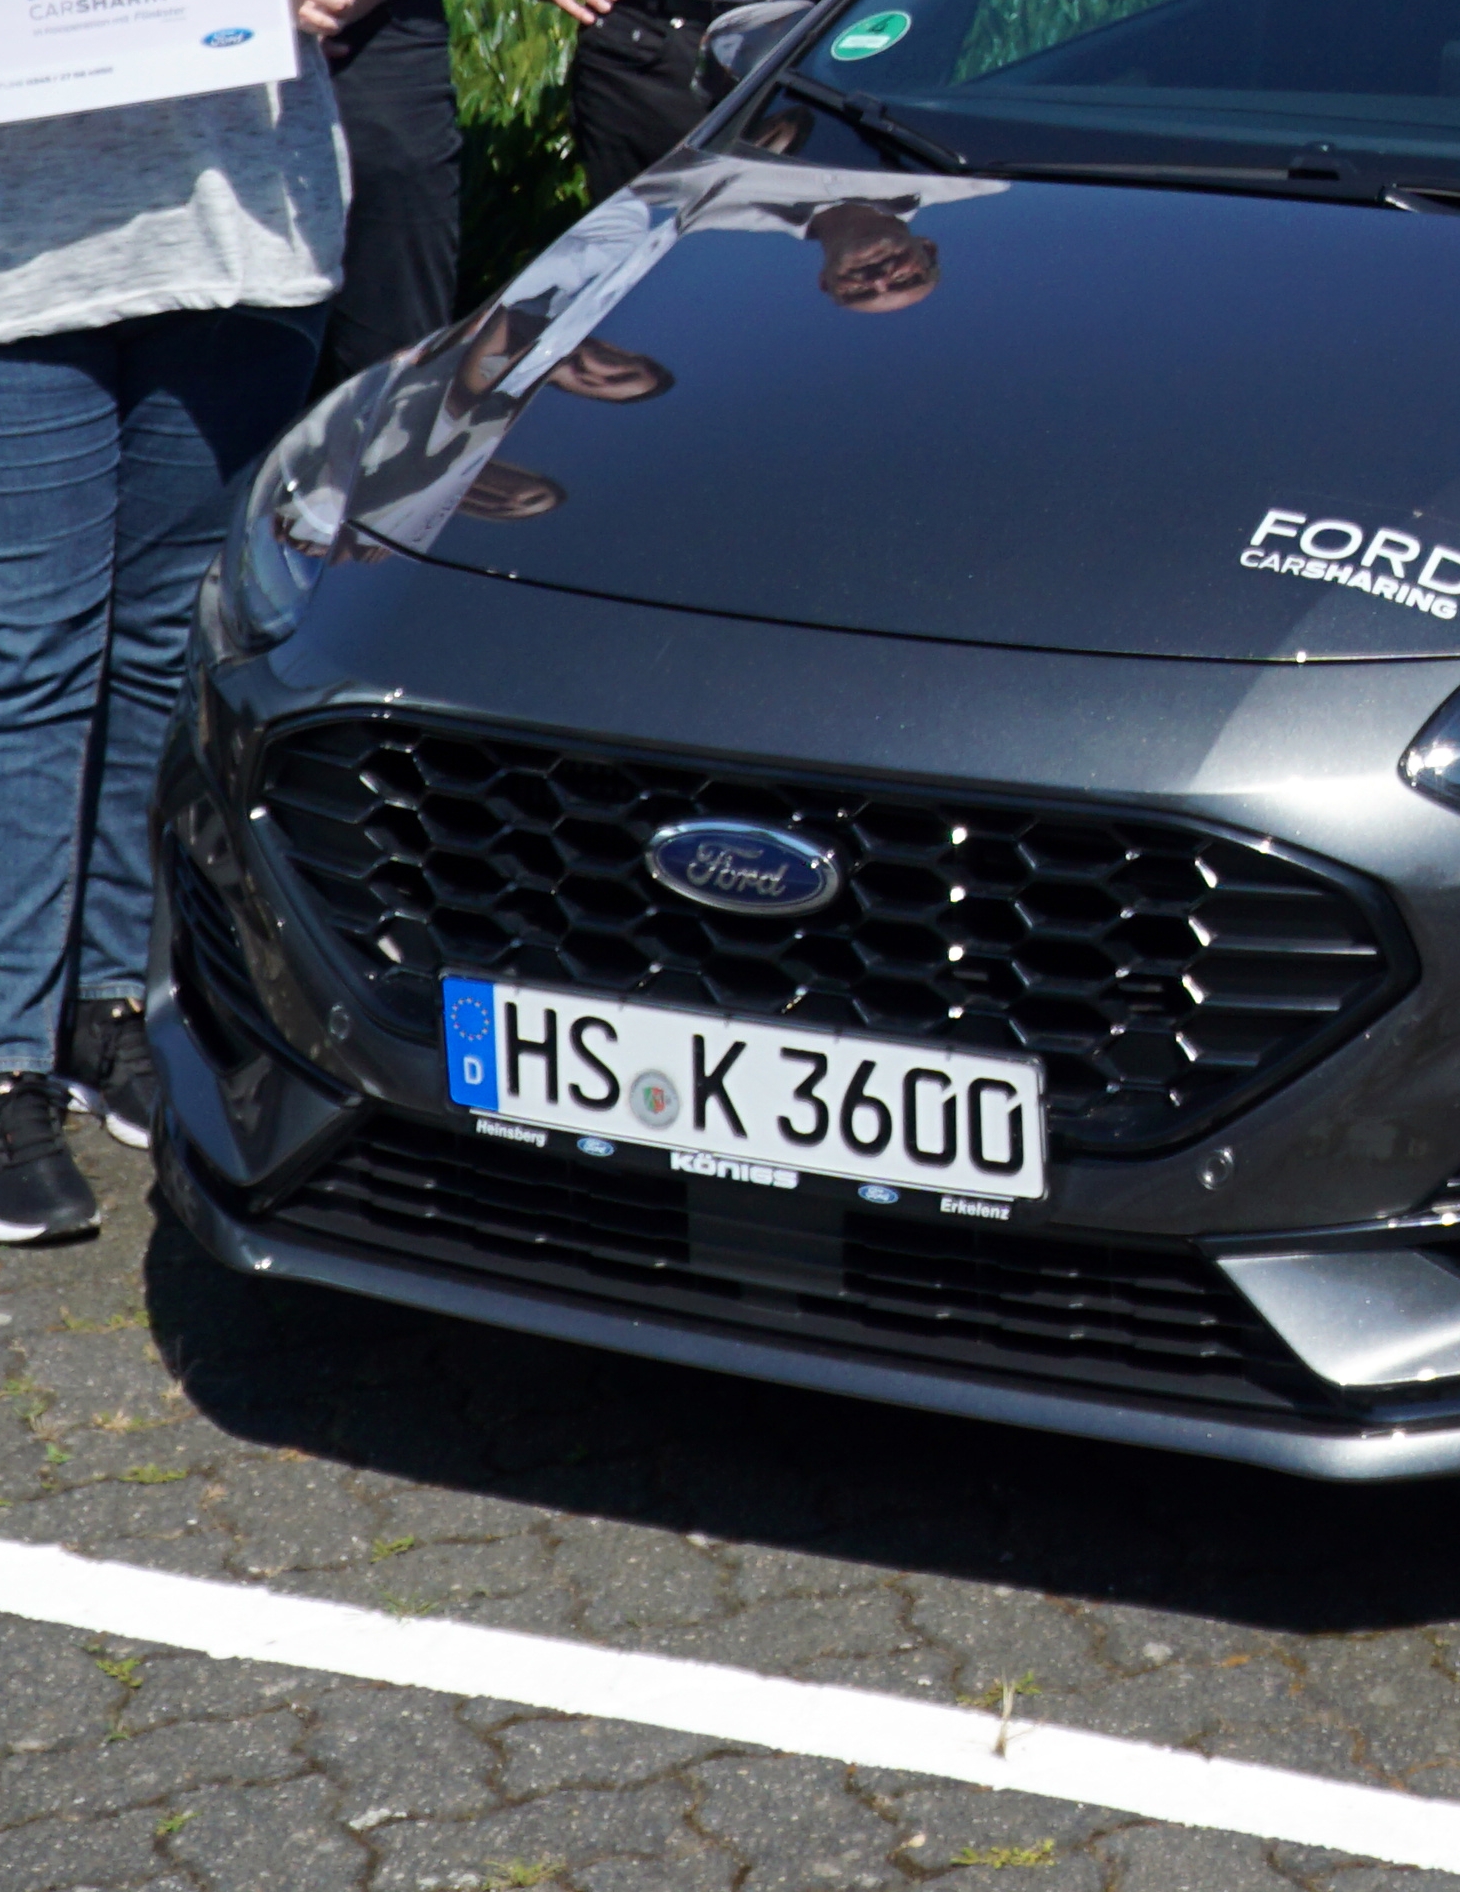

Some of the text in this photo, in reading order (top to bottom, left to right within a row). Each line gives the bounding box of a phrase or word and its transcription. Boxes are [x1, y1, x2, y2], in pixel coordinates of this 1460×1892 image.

[1239, 545, 1458, 620] CARSHARING
[685, 839, 787, 897] Ford
[463, 1054, 484, 1086] D
[503, 1001, 1024, 1176] HS K 3600
[476, 1118, 548, 1148] Heinsberg
[940, 1196, 1012, 1222] Erkelenz
